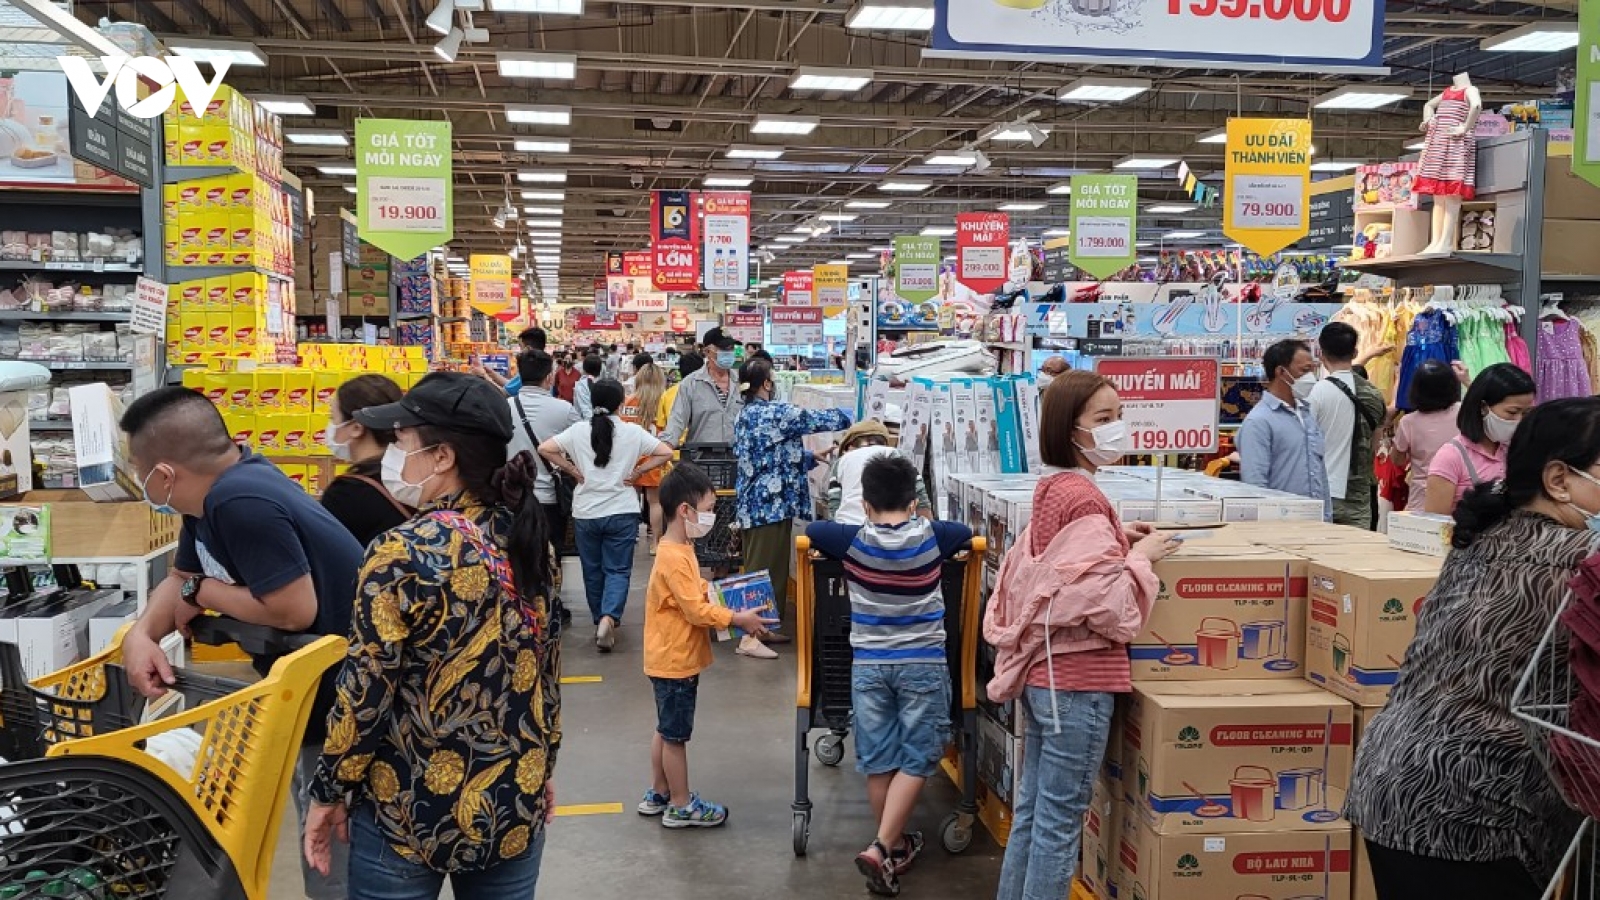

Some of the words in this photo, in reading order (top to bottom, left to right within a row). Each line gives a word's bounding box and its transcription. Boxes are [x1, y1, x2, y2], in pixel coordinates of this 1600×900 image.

[371, 131, 400, 148] GIÁ
[404, 132, 437, 149] TỐT
[1268, 133, 1293, 147] ĐÃI
[365, 148, 395, 165] MỖI
[400, 151, 443, 167] NGÀY
[1231, 149, 1275, 163] THÀNH
[1276, 150, 1306, 164] VIÊN
[1080, 183, 1101, 195] GIÁ
[1104, 184, 1127, 196] TỐT
[1076, 195, 1097, 209] MỖI
[1100, 196, 1131, 209] NGÀY
[961, 218, 1004, 231] KHUYẾN
[657, 249, 693, 267] LỚN
[1169, 369, 1201, 390] MÃI
[1131, 428, 1212, 450] 199.000
[1182, 583, 1214, 593] FLOOR
[1215, 583, 1265, 592] CLEANING
[1266, 583, 1284, 592] KIT
[1216, 730, 1250, 740] FLOOR
[1252, 729, 1303, 740] CLEANING
[1305, 729, 1325, 739] KIT
[1246, 858, 1264, 872] BỘ
[1265, 858, 1287, 869] LAU
[1290, 856, 1315, 868] NHÀ
